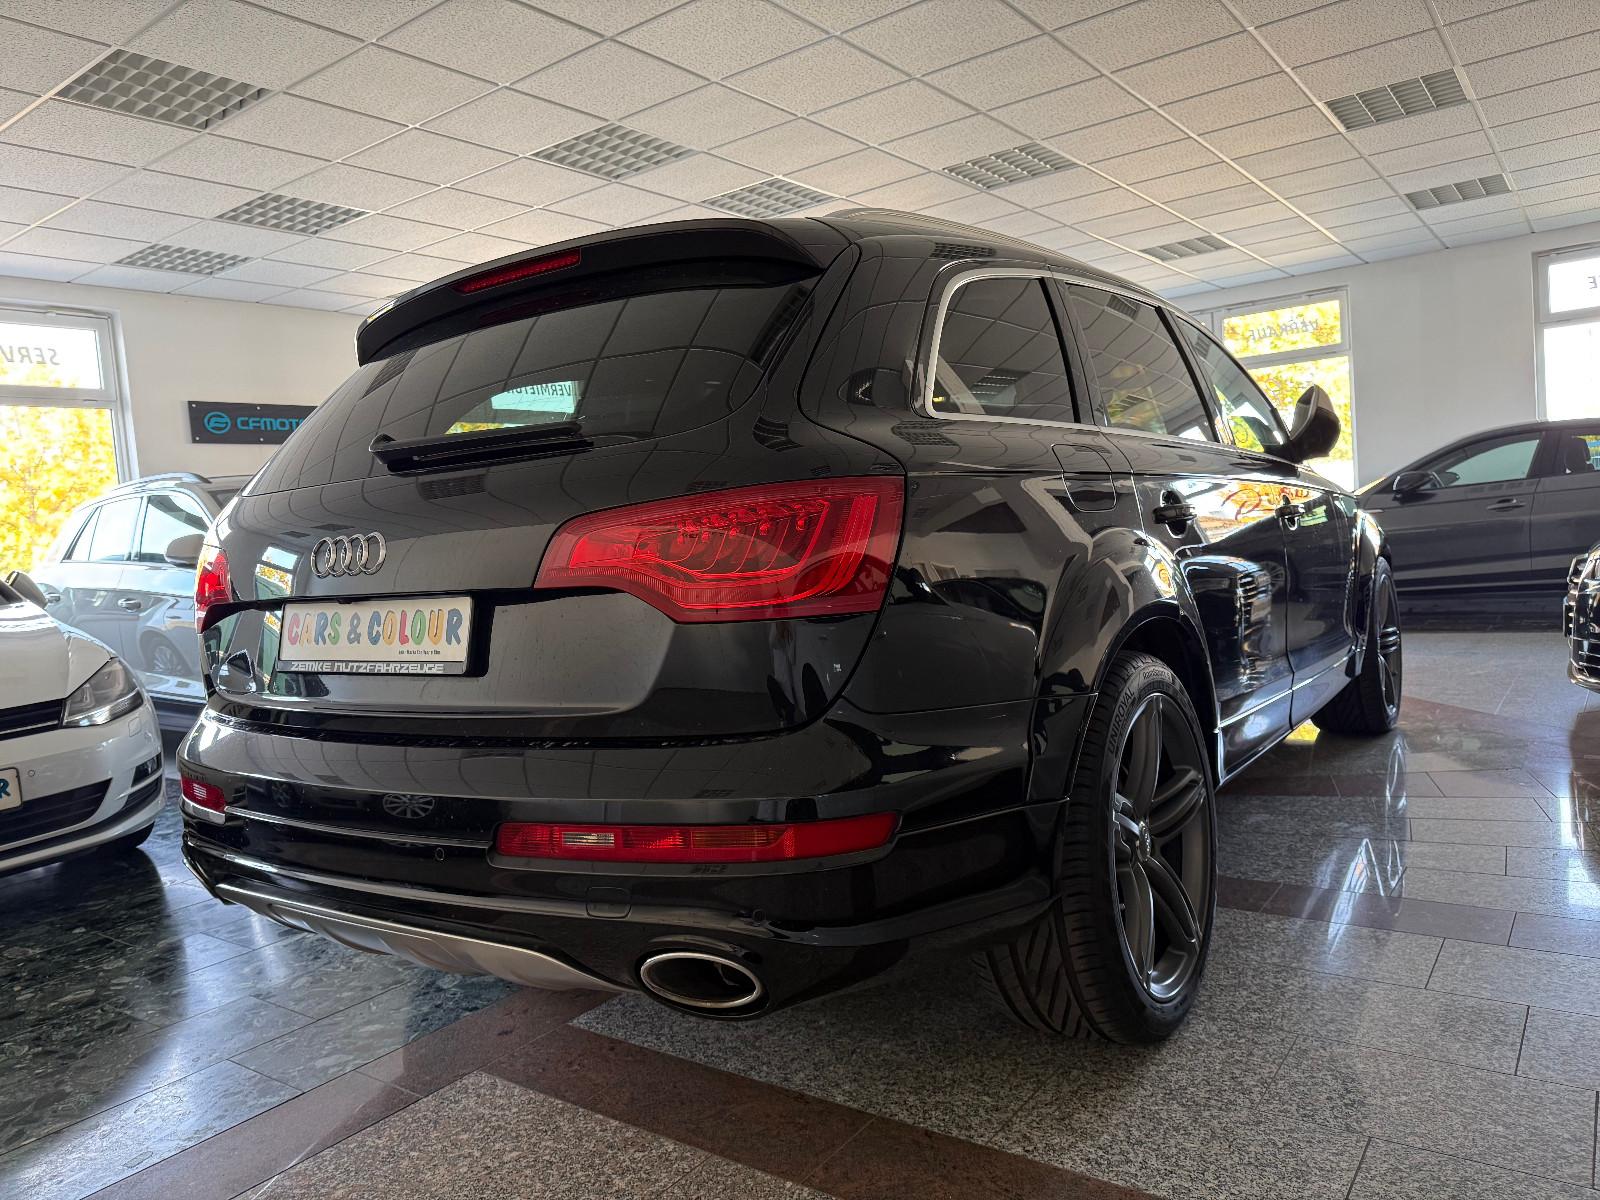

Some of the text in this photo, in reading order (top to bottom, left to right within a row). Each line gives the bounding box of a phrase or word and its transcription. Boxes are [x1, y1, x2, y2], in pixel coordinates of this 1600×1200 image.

[287, 608, 463, 647] CARS & COLOUR
[290, 661, 444, 674] ZEMKE NUTZFAHRZEUGE
[1108, 687, 1135, 754] UNIROYAL
